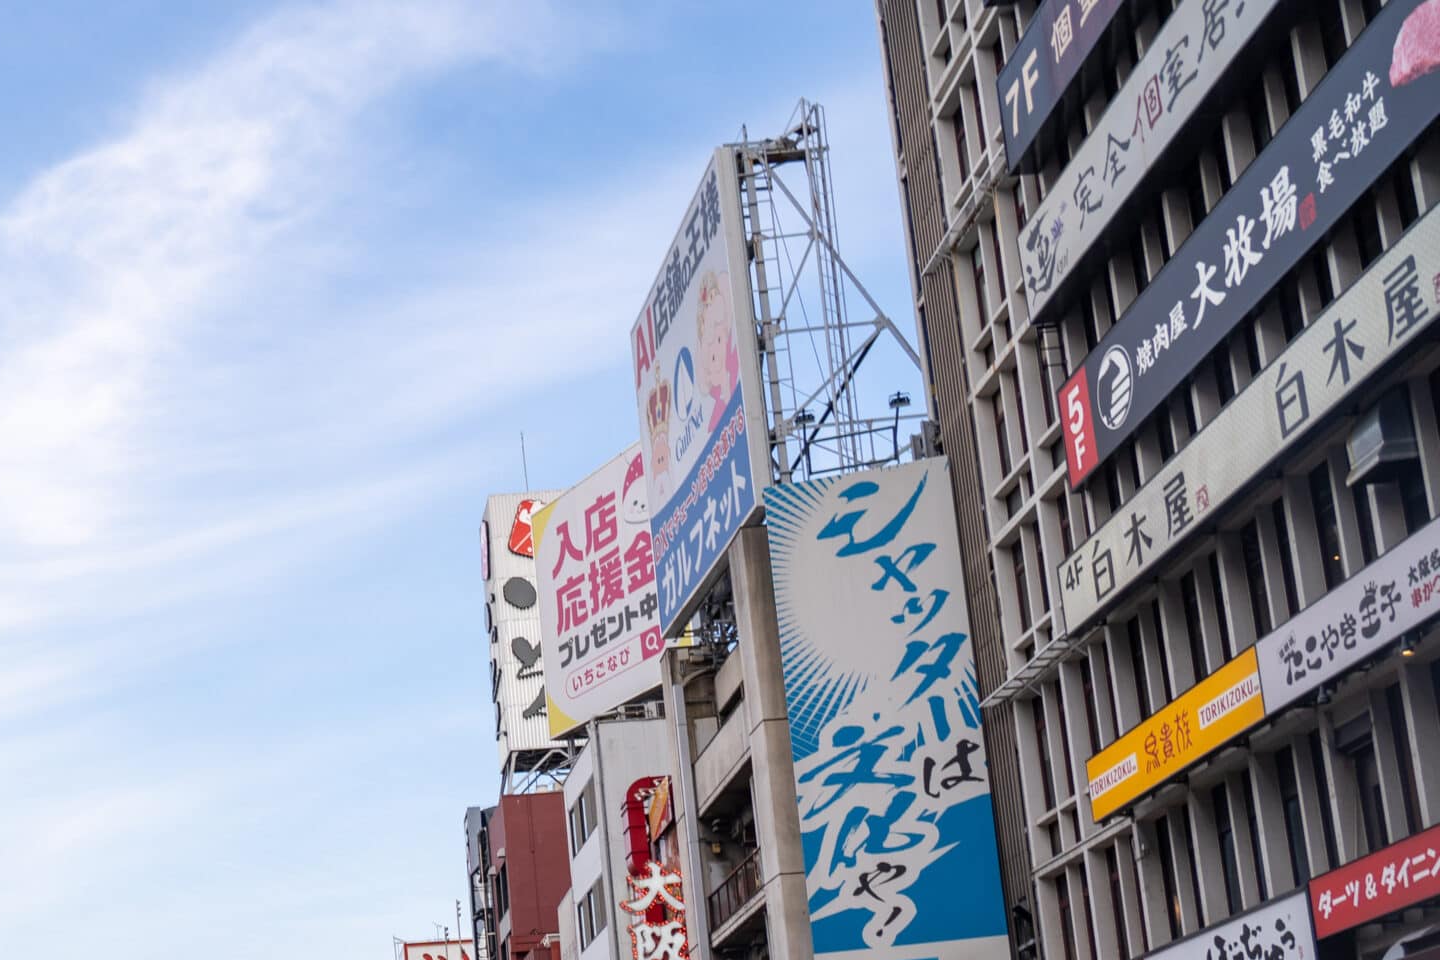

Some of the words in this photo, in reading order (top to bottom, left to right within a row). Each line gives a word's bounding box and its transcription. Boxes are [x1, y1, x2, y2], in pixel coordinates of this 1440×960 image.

[1004, 48, 1040, 137] 7F
[1073, 0, 1245, 231] 完全個室居
[1310, 70, 1380, 164] 黒毛和牛
[1316, 96, 1389, 194] 食べ放題
[636, 170, 721, 389] AI店舗の王様
[1135, 300, 1188, 378] 焼肉屋
[1190, 165, 1299, 330] 大牧場
[1277, 253, 1430, 439] 白木屋
[1066, 384, 1086, 472] 5F
[552, 488, 617, 579] 入店
[661, 464, 747, 617] ガルフネット
[1065, 554, 1084, 591] 4F
[1091, 471, 1194, 602] 白木屋
[556, 537, 657, 637] 応援金
[559, 591, 658, 671] プレゼント中
[1283, 579, 1402, 686] たこやき王子
[571, 645, 631, 695] いちごなび
[1200, 678, 1254, 726] TORIKIZOKU
[1089, 759, 1133, 797] TORIKIZOKU
[1144, 709, 1193, 774] 鳥貴族
[1318, 878, 1360, 920] ダーツ
[1364, 872, 1377, 900] &
